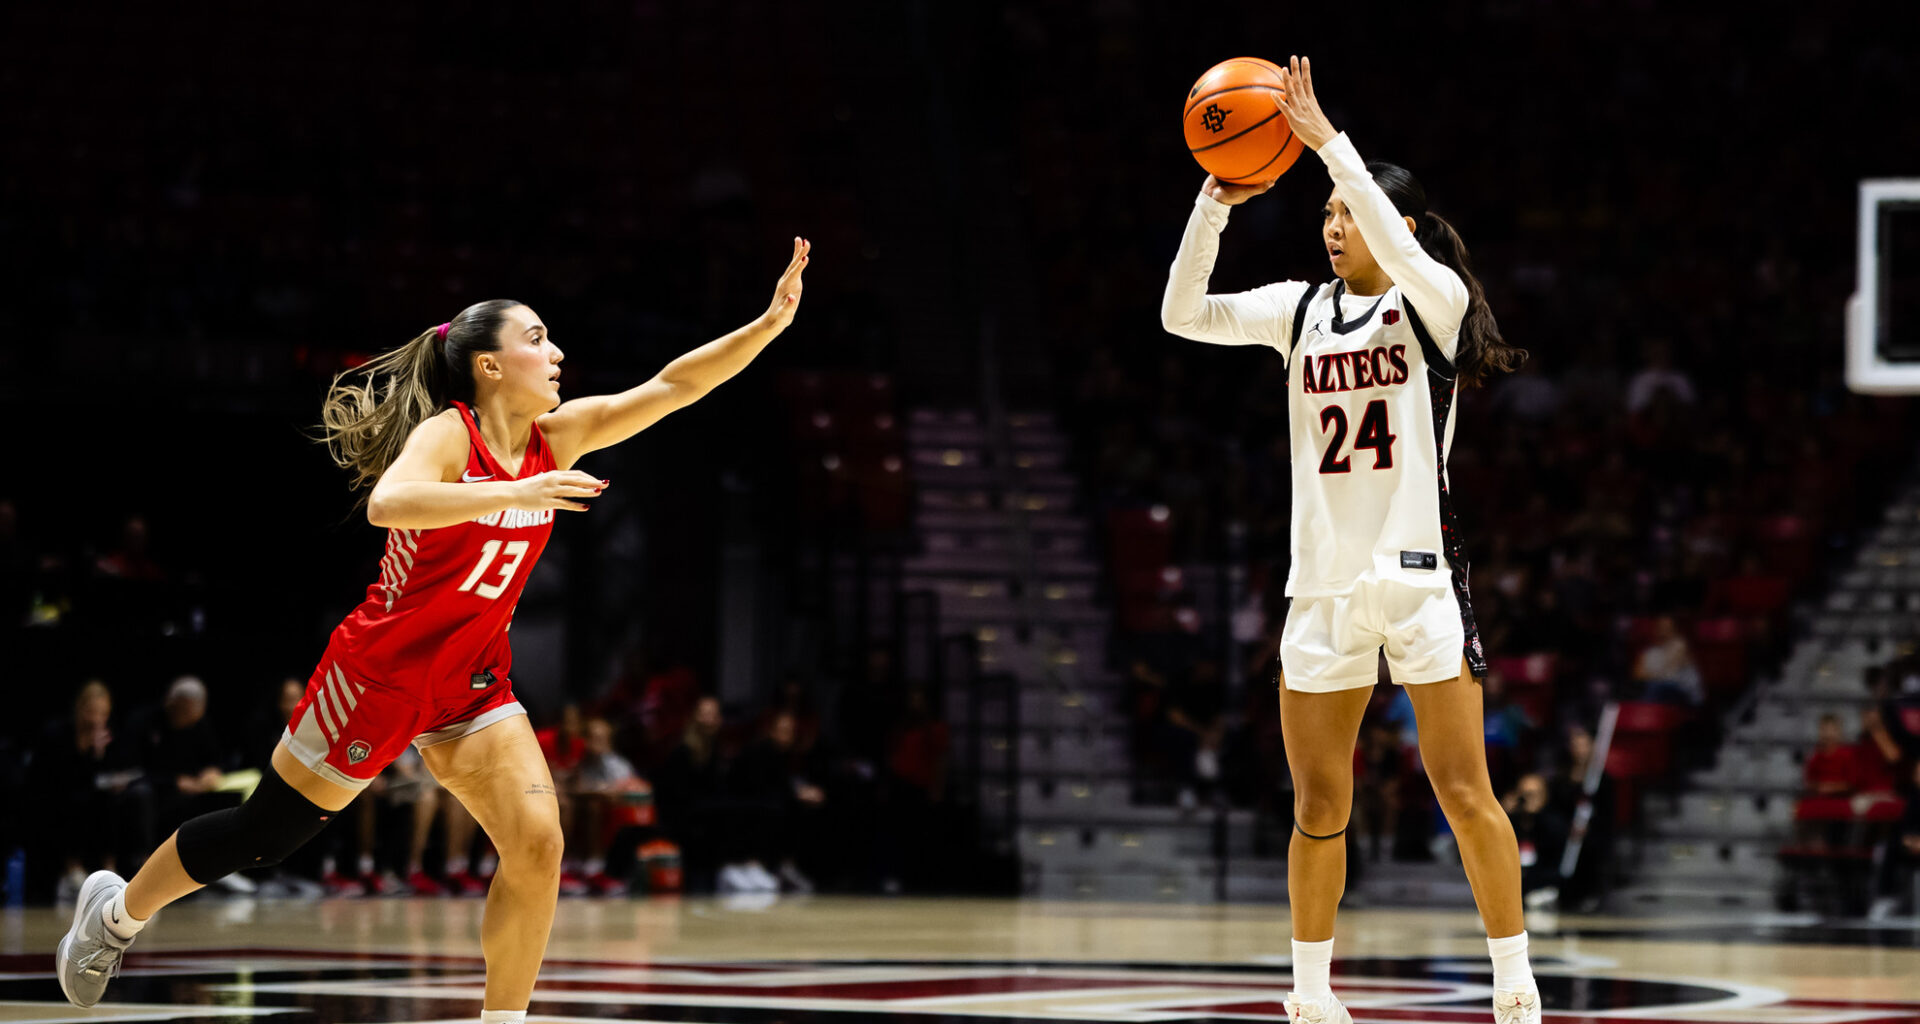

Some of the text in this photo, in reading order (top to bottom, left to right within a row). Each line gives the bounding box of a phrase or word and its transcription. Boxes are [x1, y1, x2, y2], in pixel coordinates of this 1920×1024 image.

[1303, 344, 1409, 394] AZTECS
[1319, 399, 1397, 474] 24
[457, 540, 530, 599] 13
